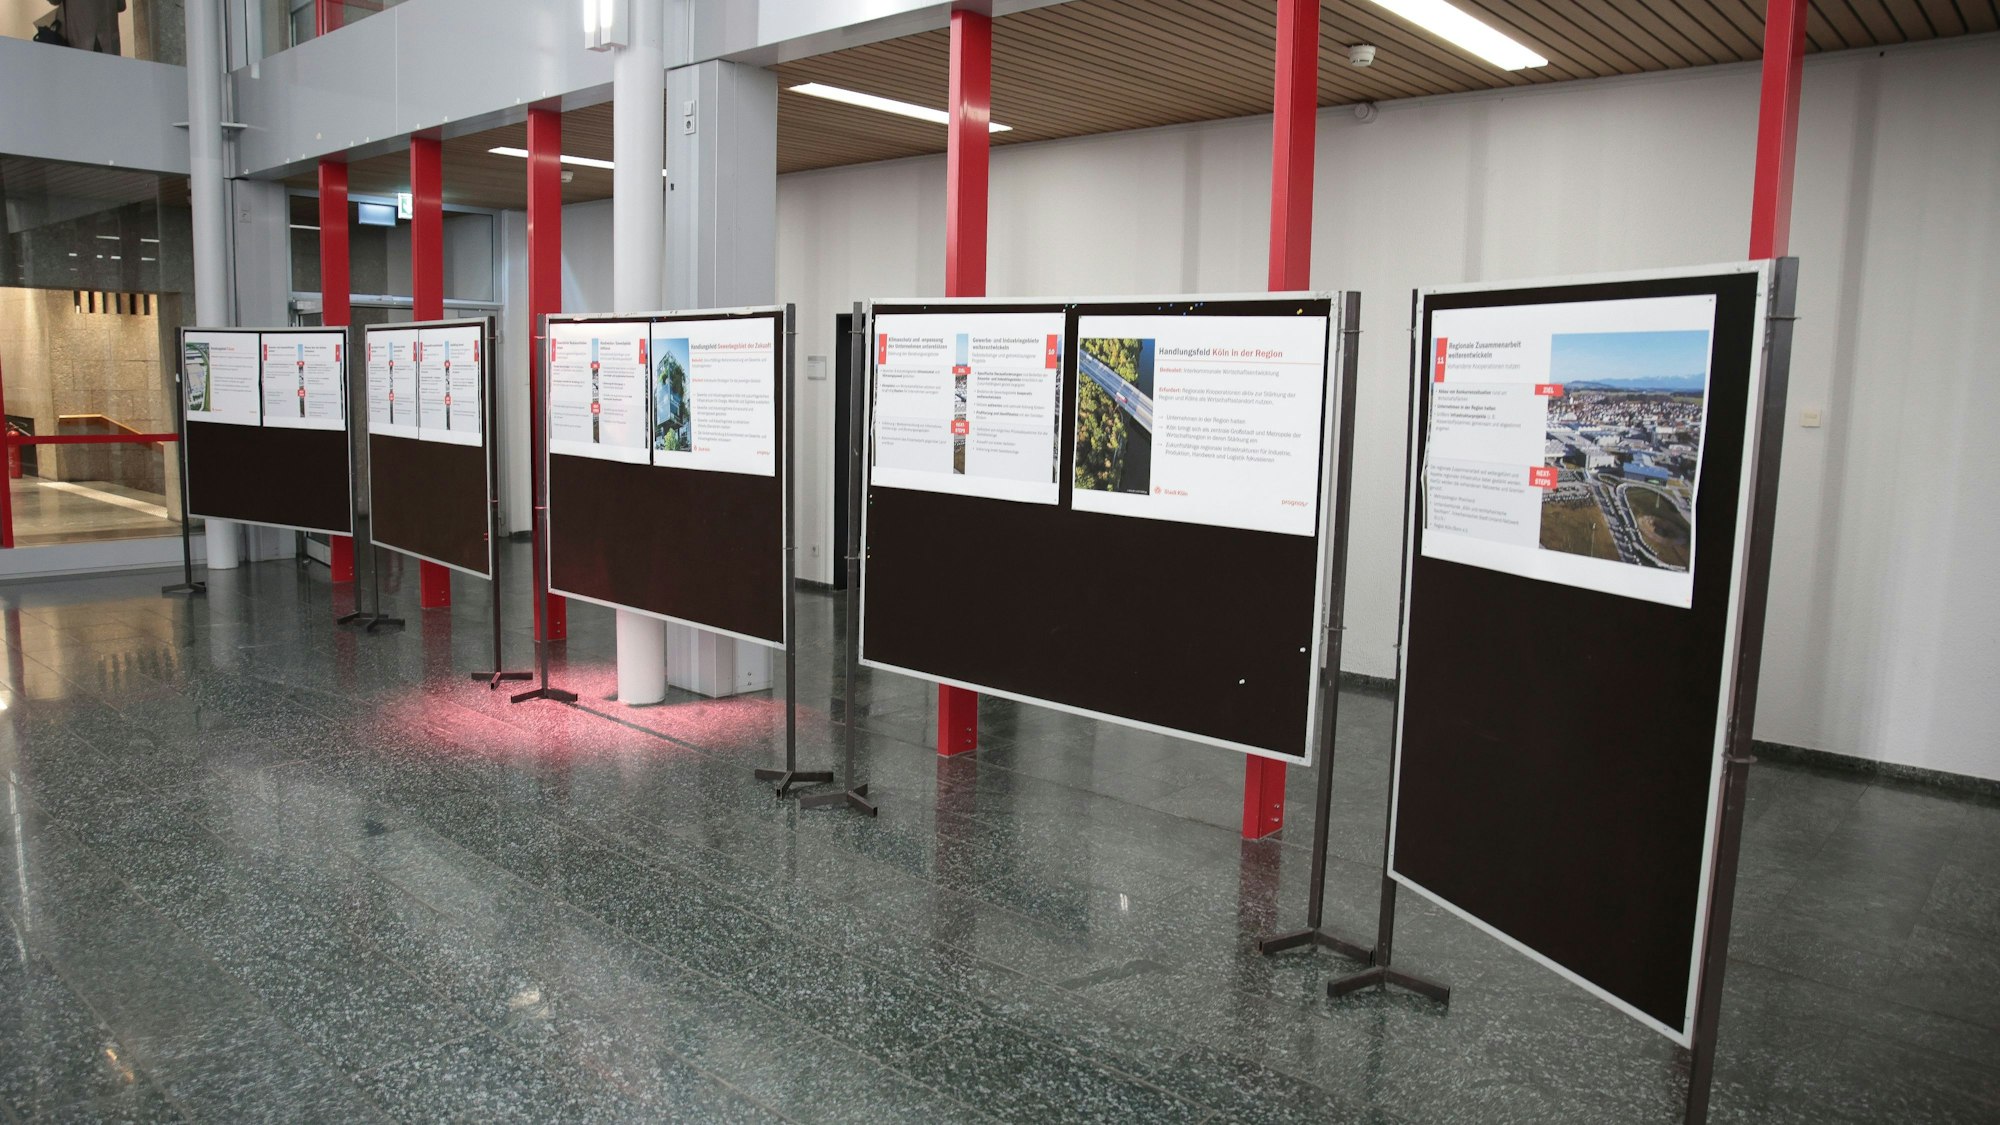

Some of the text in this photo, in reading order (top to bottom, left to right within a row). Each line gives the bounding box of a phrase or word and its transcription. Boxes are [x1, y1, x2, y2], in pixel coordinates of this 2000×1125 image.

[1449, 340, 1521, 350] Regionale Zusammenarbeit
[1159, 348, 1210, 357] Handlungsfeld
[1212, 348, 1229, 357] Köln
[1255, 350, 1283, 359] Region
[1206, 388, 1241, 396] Kooperationen
[1264, 390, 1286, 398] Stärkung
[1535, 478, 1551, 486] STEPS
